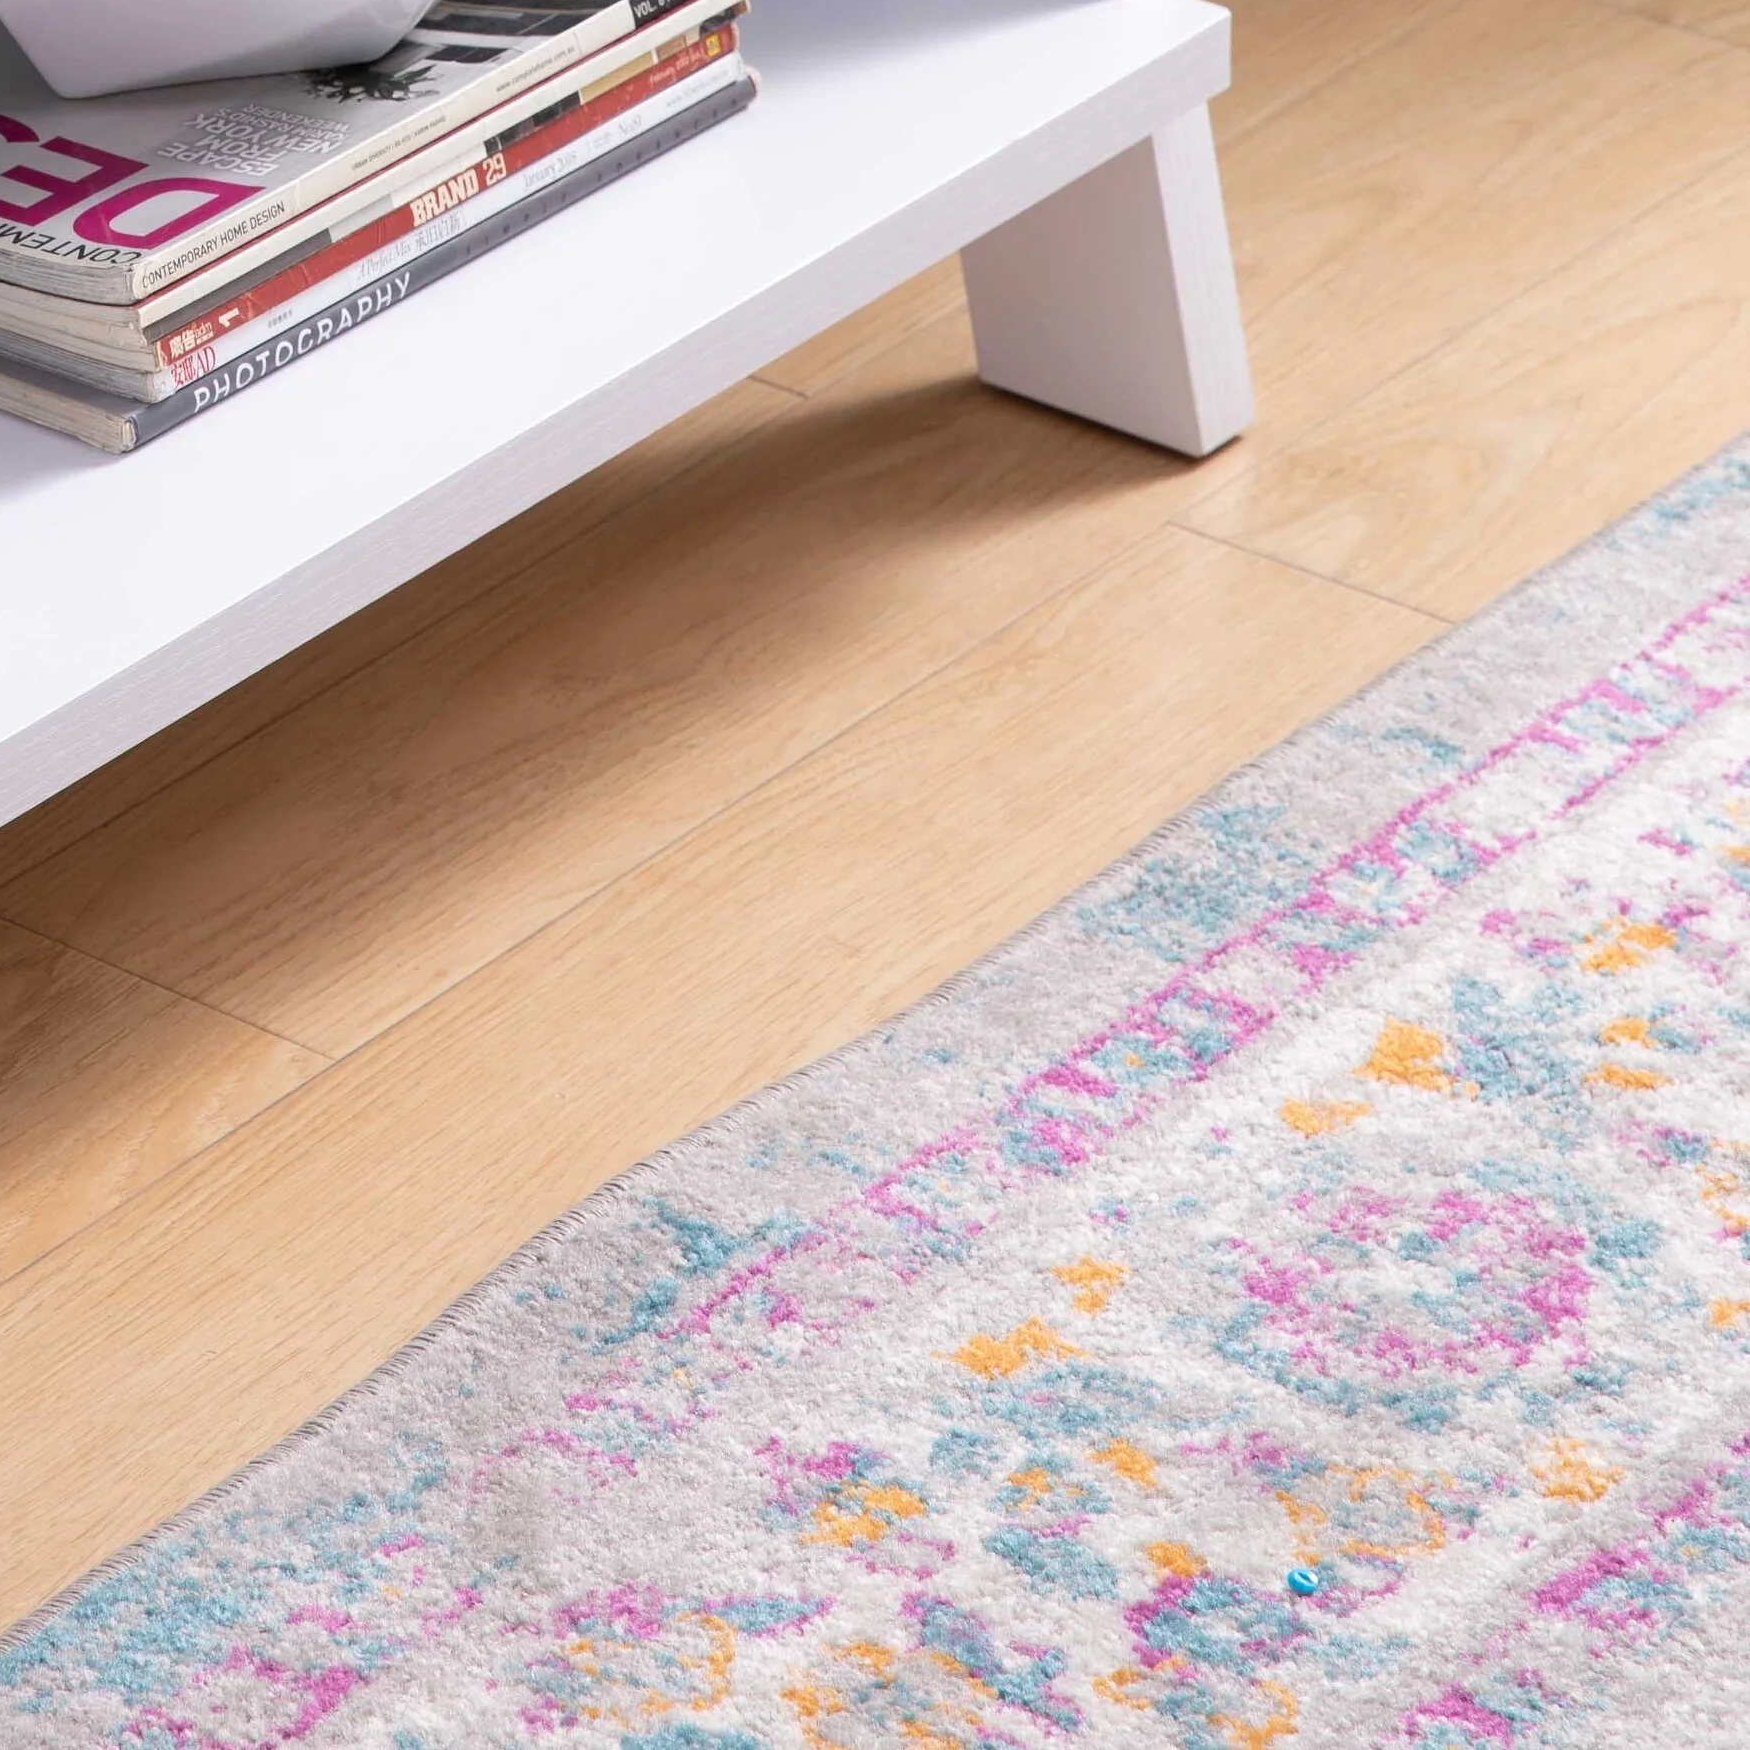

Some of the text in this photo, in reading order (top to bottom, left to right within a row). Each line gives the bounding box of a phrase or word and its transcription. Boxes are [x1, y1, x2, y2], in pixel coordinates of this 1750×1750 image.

[157, 140, 281, 177] ESCAPE
[184, 113, 343, 155] NEW YORK
[194, 135, 287, 163] FROM
[409, 152, 507, 228] BRAND 29
[142, 201, 286, 289] CONTEMPORARY HOME DESIGN
[192, 272, 411, 413] PHOTOGRAPHY
